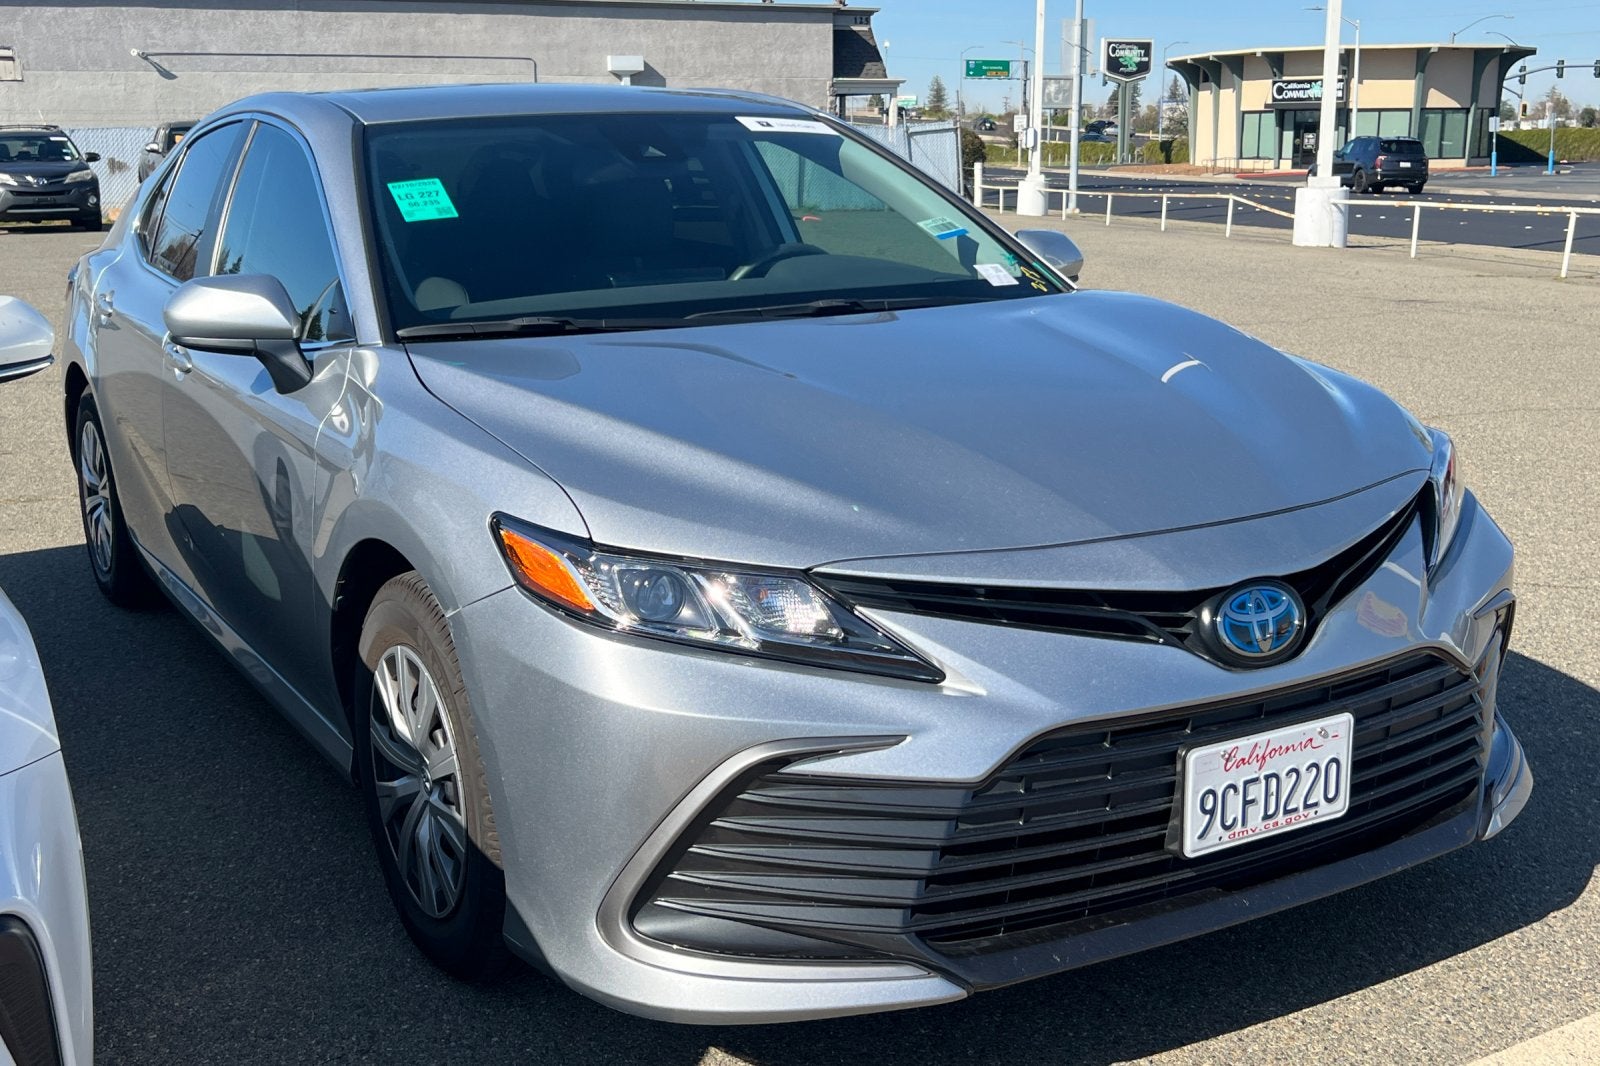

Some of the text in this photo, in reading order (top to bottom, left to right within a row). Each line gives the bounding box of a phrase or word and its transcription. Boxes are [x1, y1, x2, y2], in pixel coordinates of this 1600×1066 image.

[1283, 82, 1311, 90] California
[397, 190, 440, 201] LG 227
[1223, 737, 1324, 772] California
[1197, 757, 1341, 840] 9CFD220
[1228, 811, 1311, 841] dmv.ca.gov
